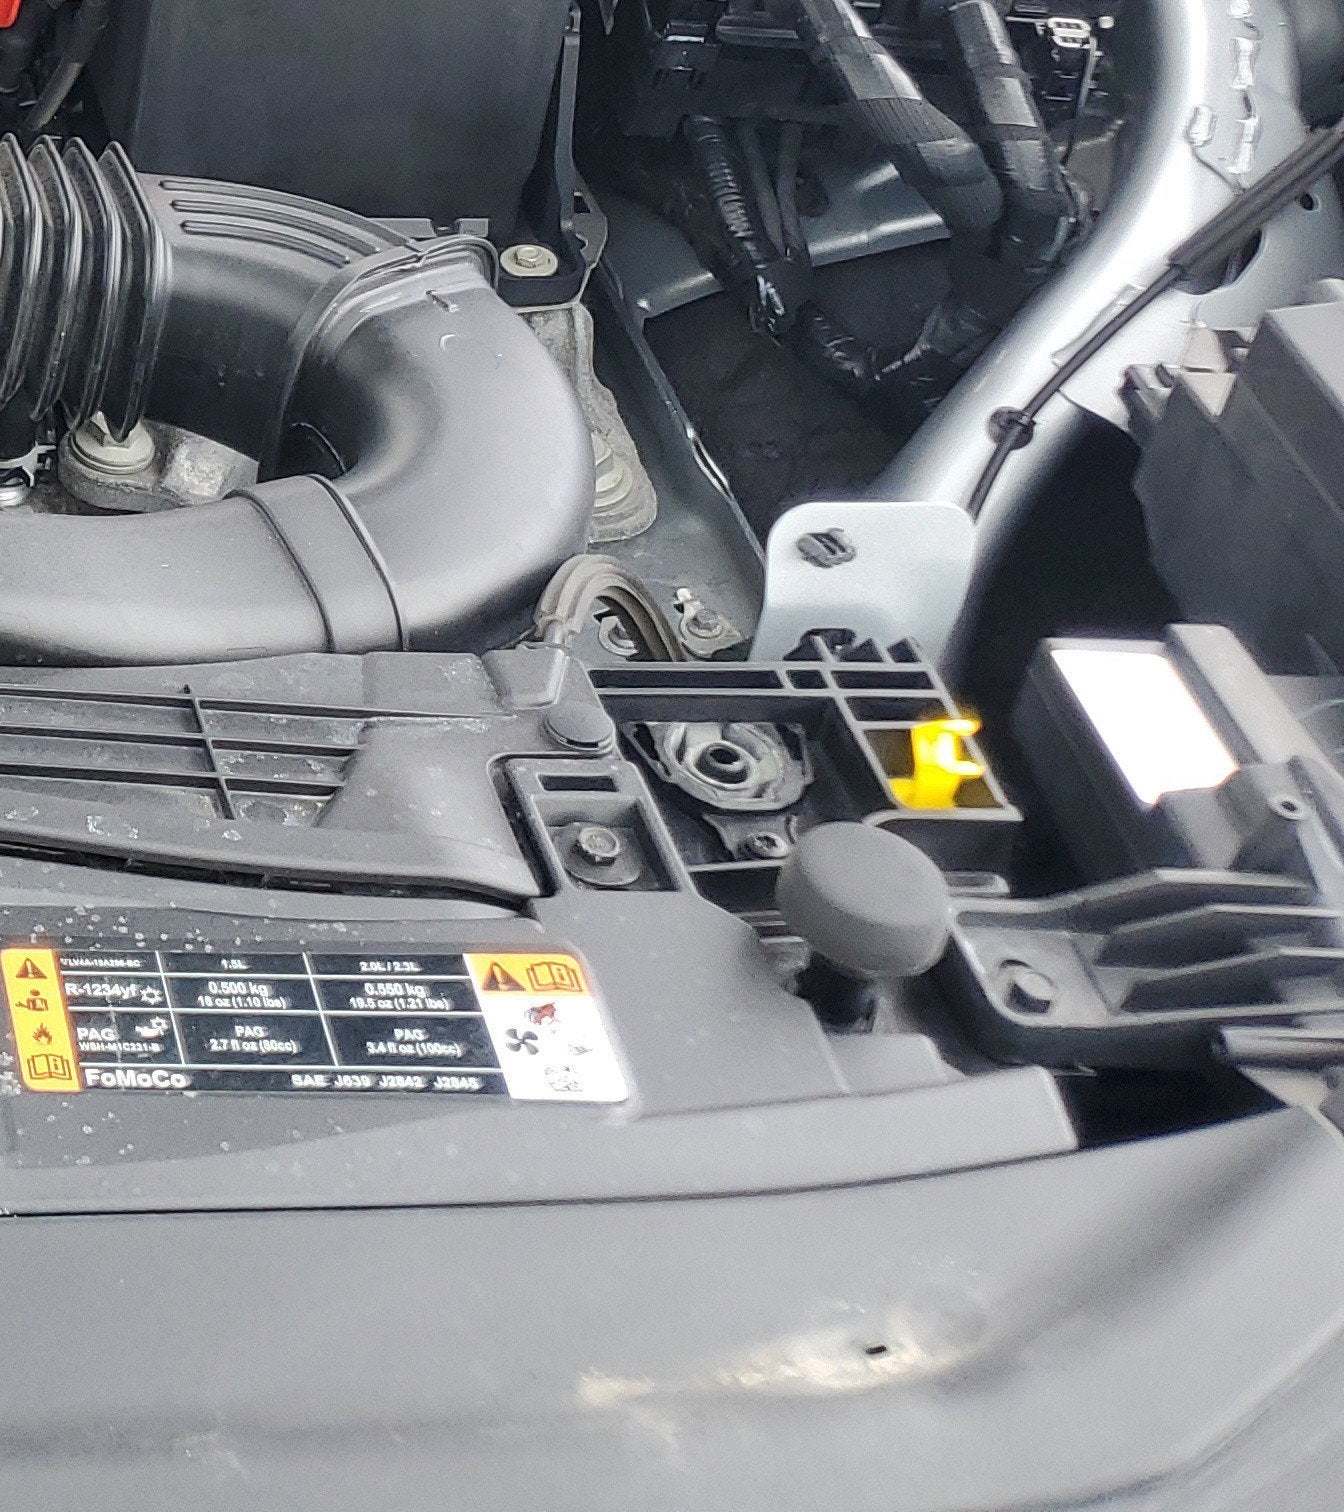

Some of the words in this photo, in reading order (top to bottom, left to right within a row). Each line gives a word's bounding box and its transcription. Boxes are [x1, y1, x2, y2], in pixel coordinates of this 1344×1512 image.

[64, 982, 137, 999] R-1234yf
[208, 981, 247, 995] 0.500
[248, 981, 269, 997] kg
[364, 982, 403, 996] 0.550
[405, 982, 427, 998] kg
[215, 999, 231, 1007] oz
[377, 999, 393, 1009] oz
[76, 1028, 115, 1041] PAG
[234, 1026, 264, 1038] PAG
[394, 1029, 425, 1041] PAG
[210, 1039, 227, 1051] 2.7
[242, 1042, 258, 1052] oz
[415, 1042, 462, 1058] (100cc)
[85, 1068, 187, 1087] FoMoCo
[291, 1074, 327, 1086] SAE
